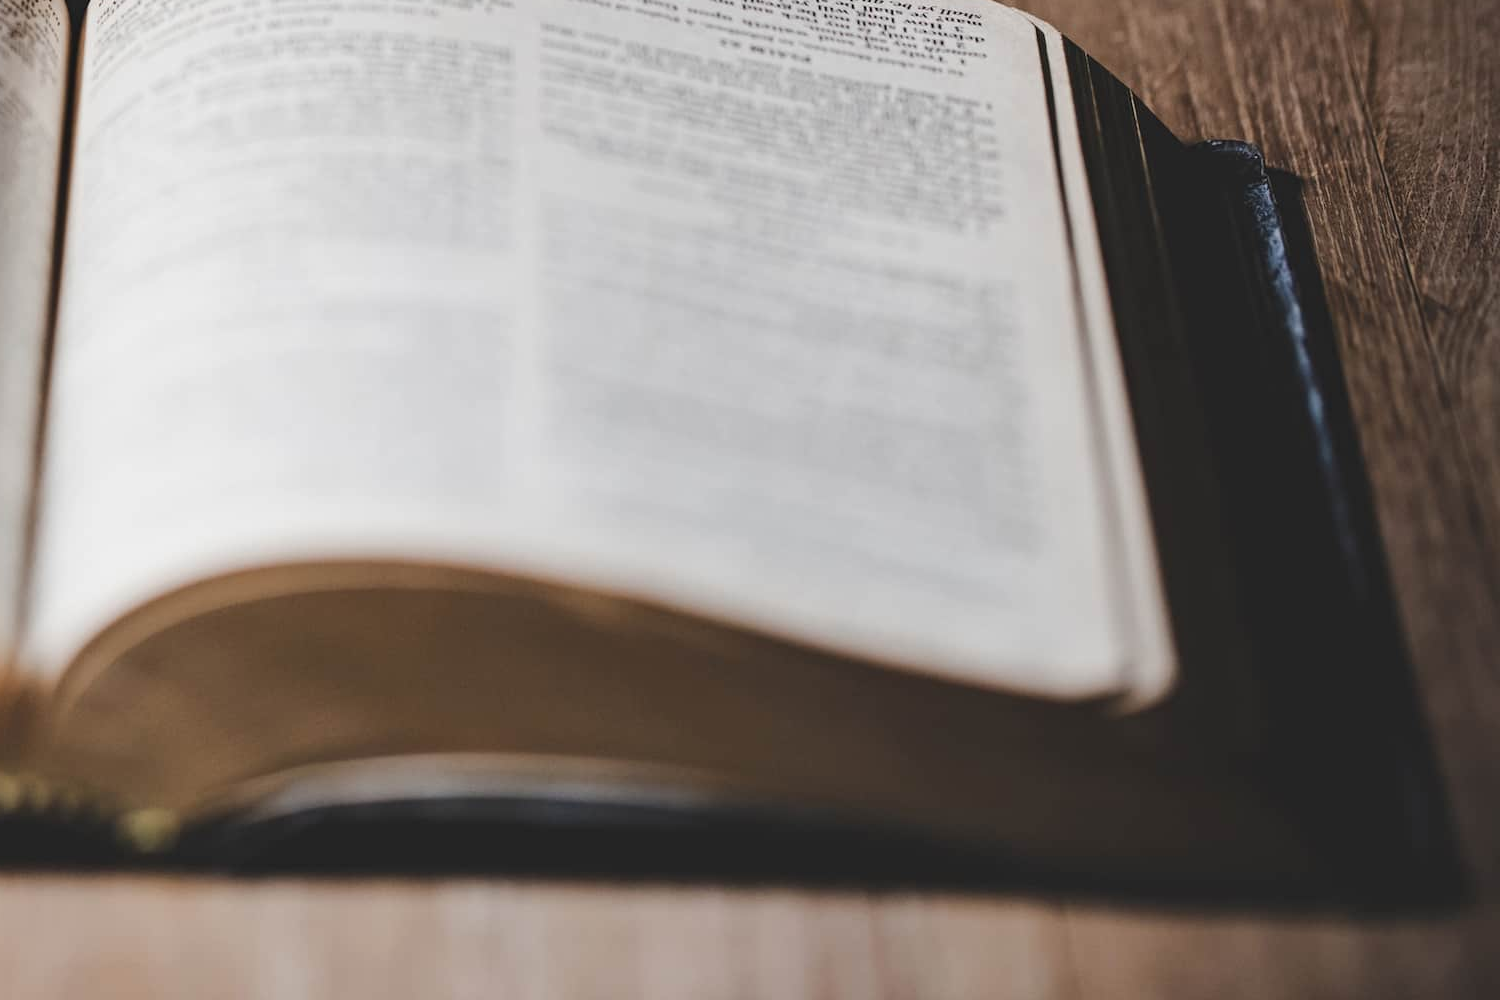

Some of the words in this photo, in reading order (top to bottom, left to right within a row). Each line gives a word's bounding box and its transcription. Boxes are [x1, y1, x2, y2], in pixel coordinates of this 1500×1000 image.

[817, 4, 848, 14] will
[835, 1, 855, 10] be
[862, 4, 902, 16] shall
[889, 0, 911, 10] be,
[796, 8, 816, 17] be
[822, 12, 850, 22] not
[855, 10, 895, 24] long
[910, 11, 927, 19] ye
[940, 8, 981, 19] shall
[855, 18, 895, 31] shall
[904, 18, 942, 30] How
[936, 15, 982, 26] man?
